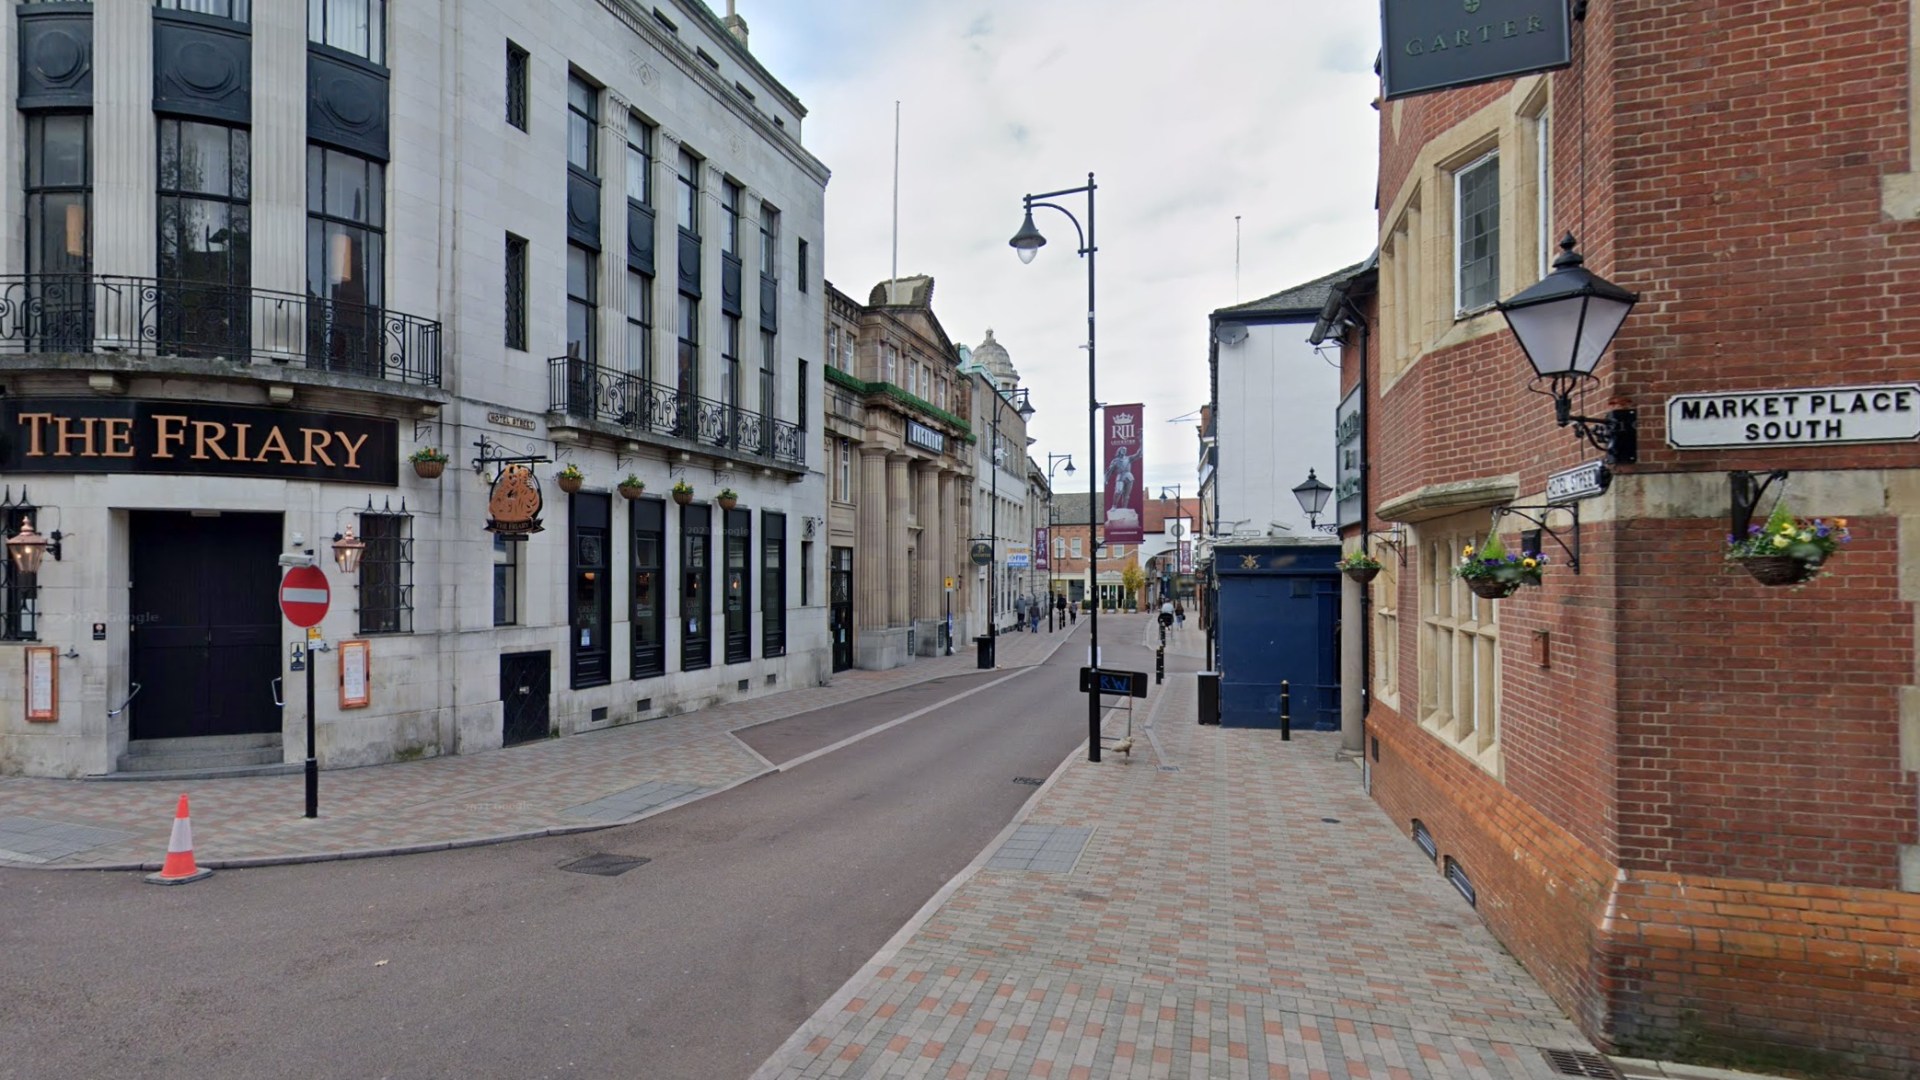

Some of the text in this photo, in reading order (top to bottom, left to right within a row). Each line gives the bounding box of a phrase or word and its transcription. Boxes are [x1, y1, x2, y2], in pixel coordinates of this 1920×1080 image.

[1406, 15, 1545, 56] GARTER
[1681, 391, 1911, 419] MARKET PLACE
[490, 415, 534, 428] HOTEL STREET
[1745, 419, 1842, 441] SOUTH
[18, 412, 368, 469] THE FRIARY
[1547, 468, 1597, 495] HOTEL STREET
